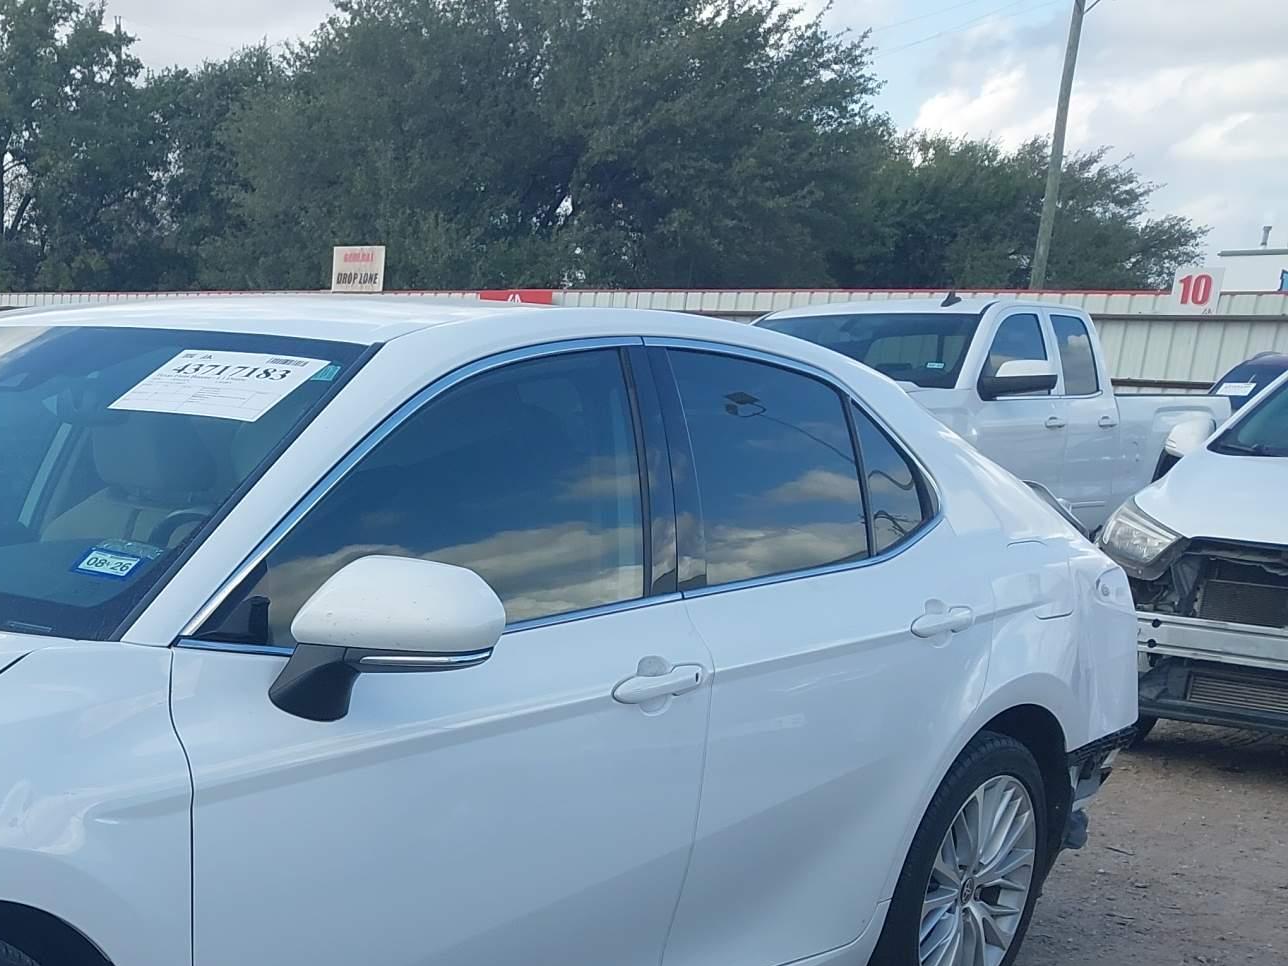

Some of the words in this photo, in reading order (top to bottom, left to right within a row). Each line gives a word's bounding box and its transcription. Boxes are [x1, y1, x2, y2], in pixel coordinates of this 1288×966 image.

[336, 272, 358, 285] DROP
[358, 272, 378, 285] ZONE
[1178, 274, 1213, 305] 10
[172, 362, 291, 381] 43717183
